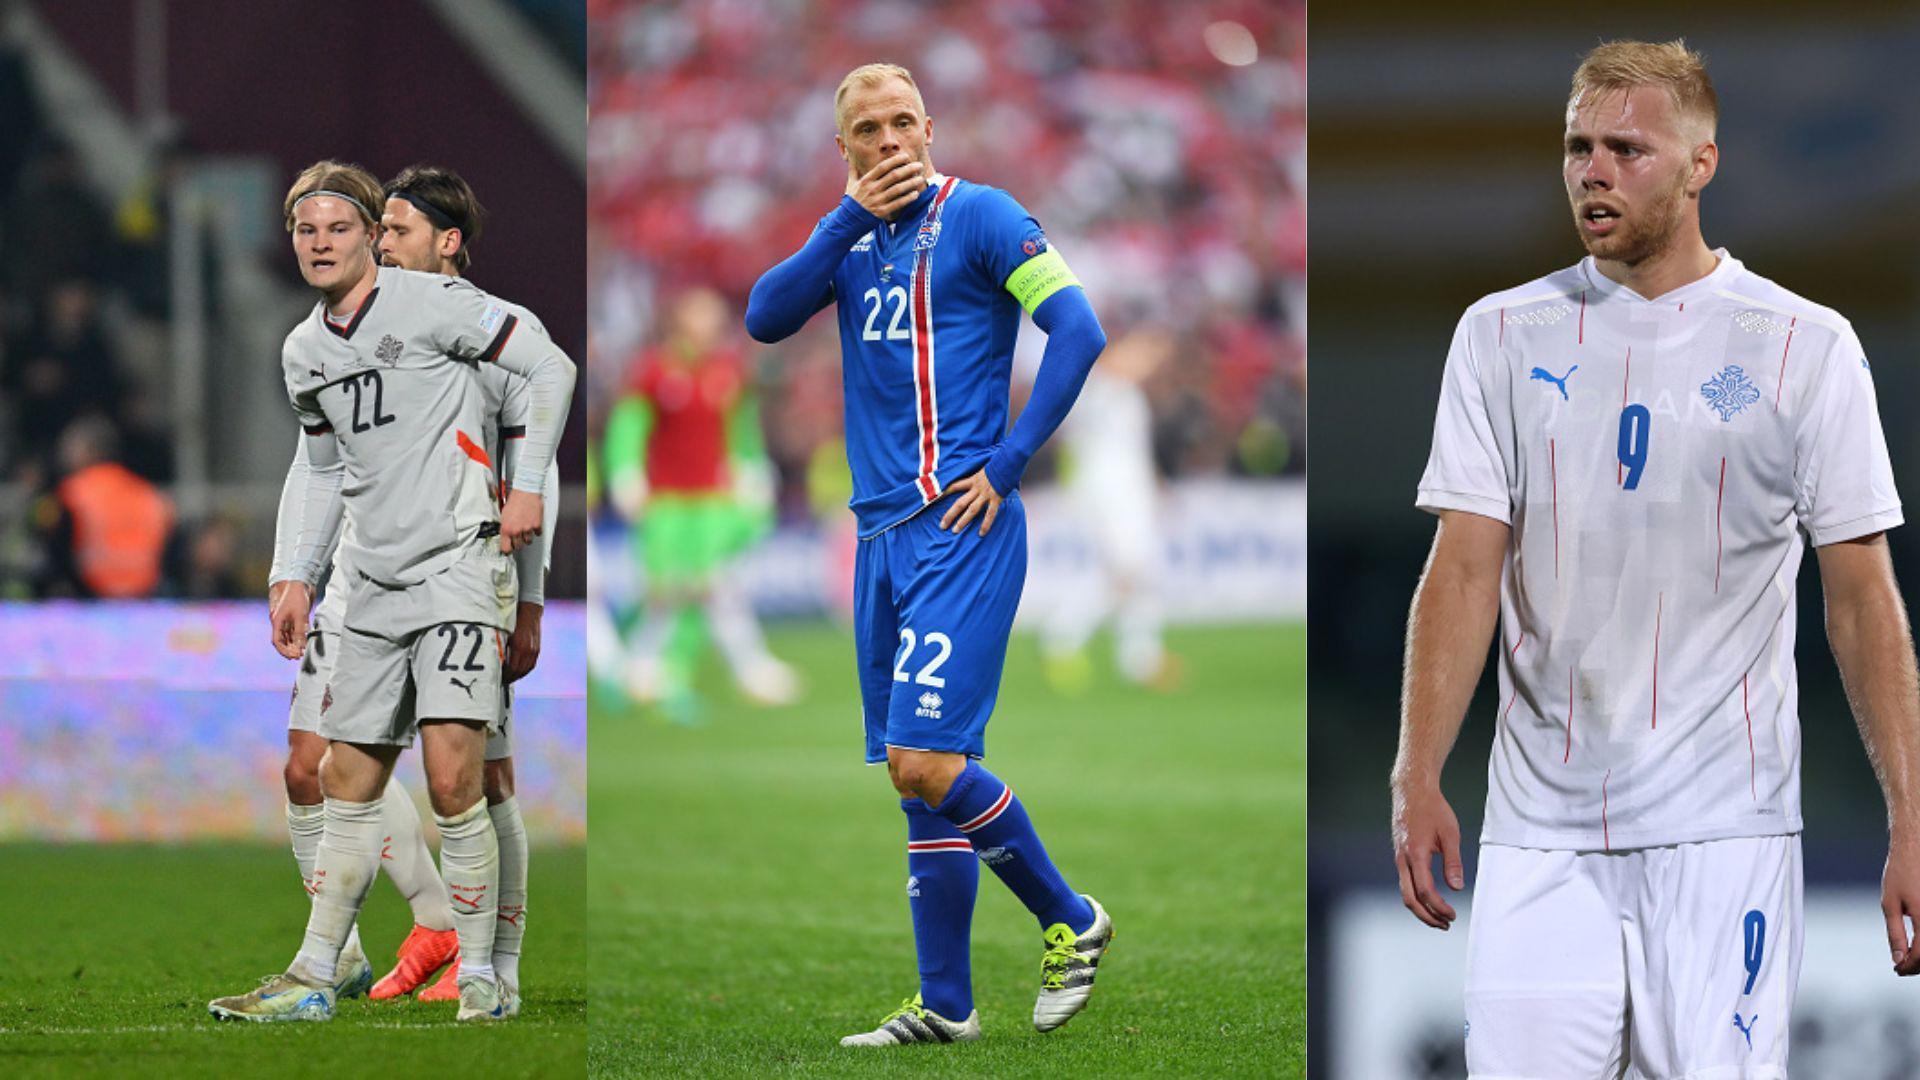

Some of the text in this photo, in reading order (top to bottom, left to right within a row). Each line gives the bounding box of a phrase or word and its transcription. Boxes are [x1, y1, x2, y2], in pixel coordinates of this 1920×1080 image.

[862, 285, 910, 341] 22
[343, 369, 395, 433] 22
[1617, 404, 1650, 489] 9
[438, 623, 484, 671] 22
[893, 627, 952, 688] 22
[1743, 910, 1766, 995] 9
